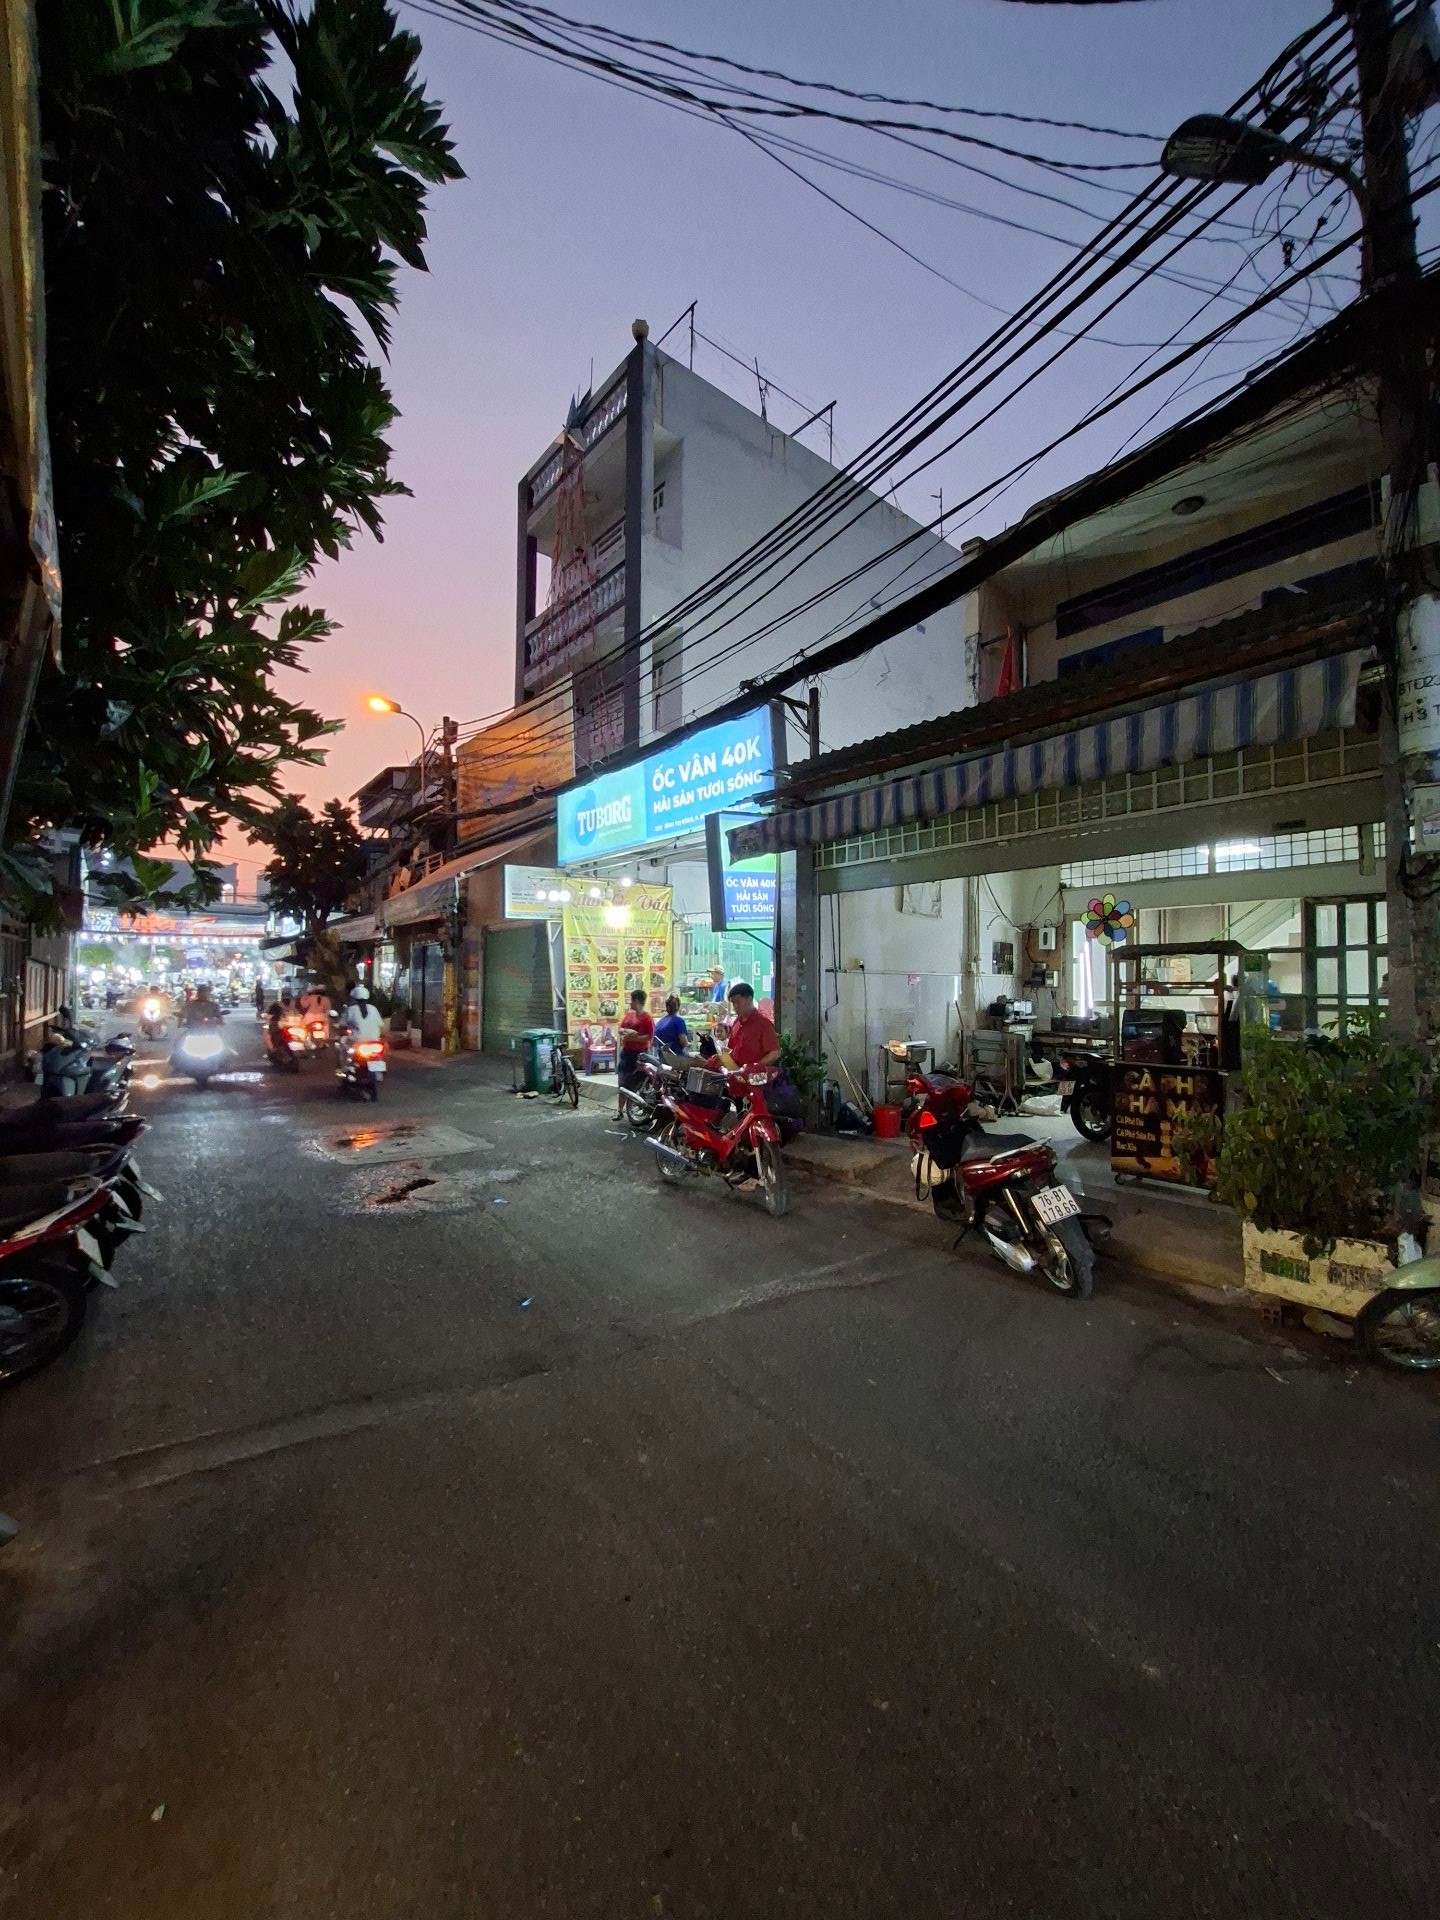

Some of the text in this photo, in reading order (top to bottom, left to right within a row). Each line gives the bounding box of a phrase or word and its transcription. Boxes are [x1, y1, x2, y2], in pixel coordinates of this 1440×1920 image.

[652, 736, 761, 792] ỐC VÂN 40K
[653, 769, 763, 814] HẢI SẢN TƯƠI SỐNG
[577, 794, 632, 837] TUBORG
[726, 876, 738, 888] ỐC
[760, 879, 776, 888] 40K
[731, 902, 774, 912] TƯƠI SỐNG
[736, 890, 768, 901] HẢI SẢN
[1124, 1068, 1156, 1092] CÀ
[1043, 1200, 1078, 1222] 178.66
